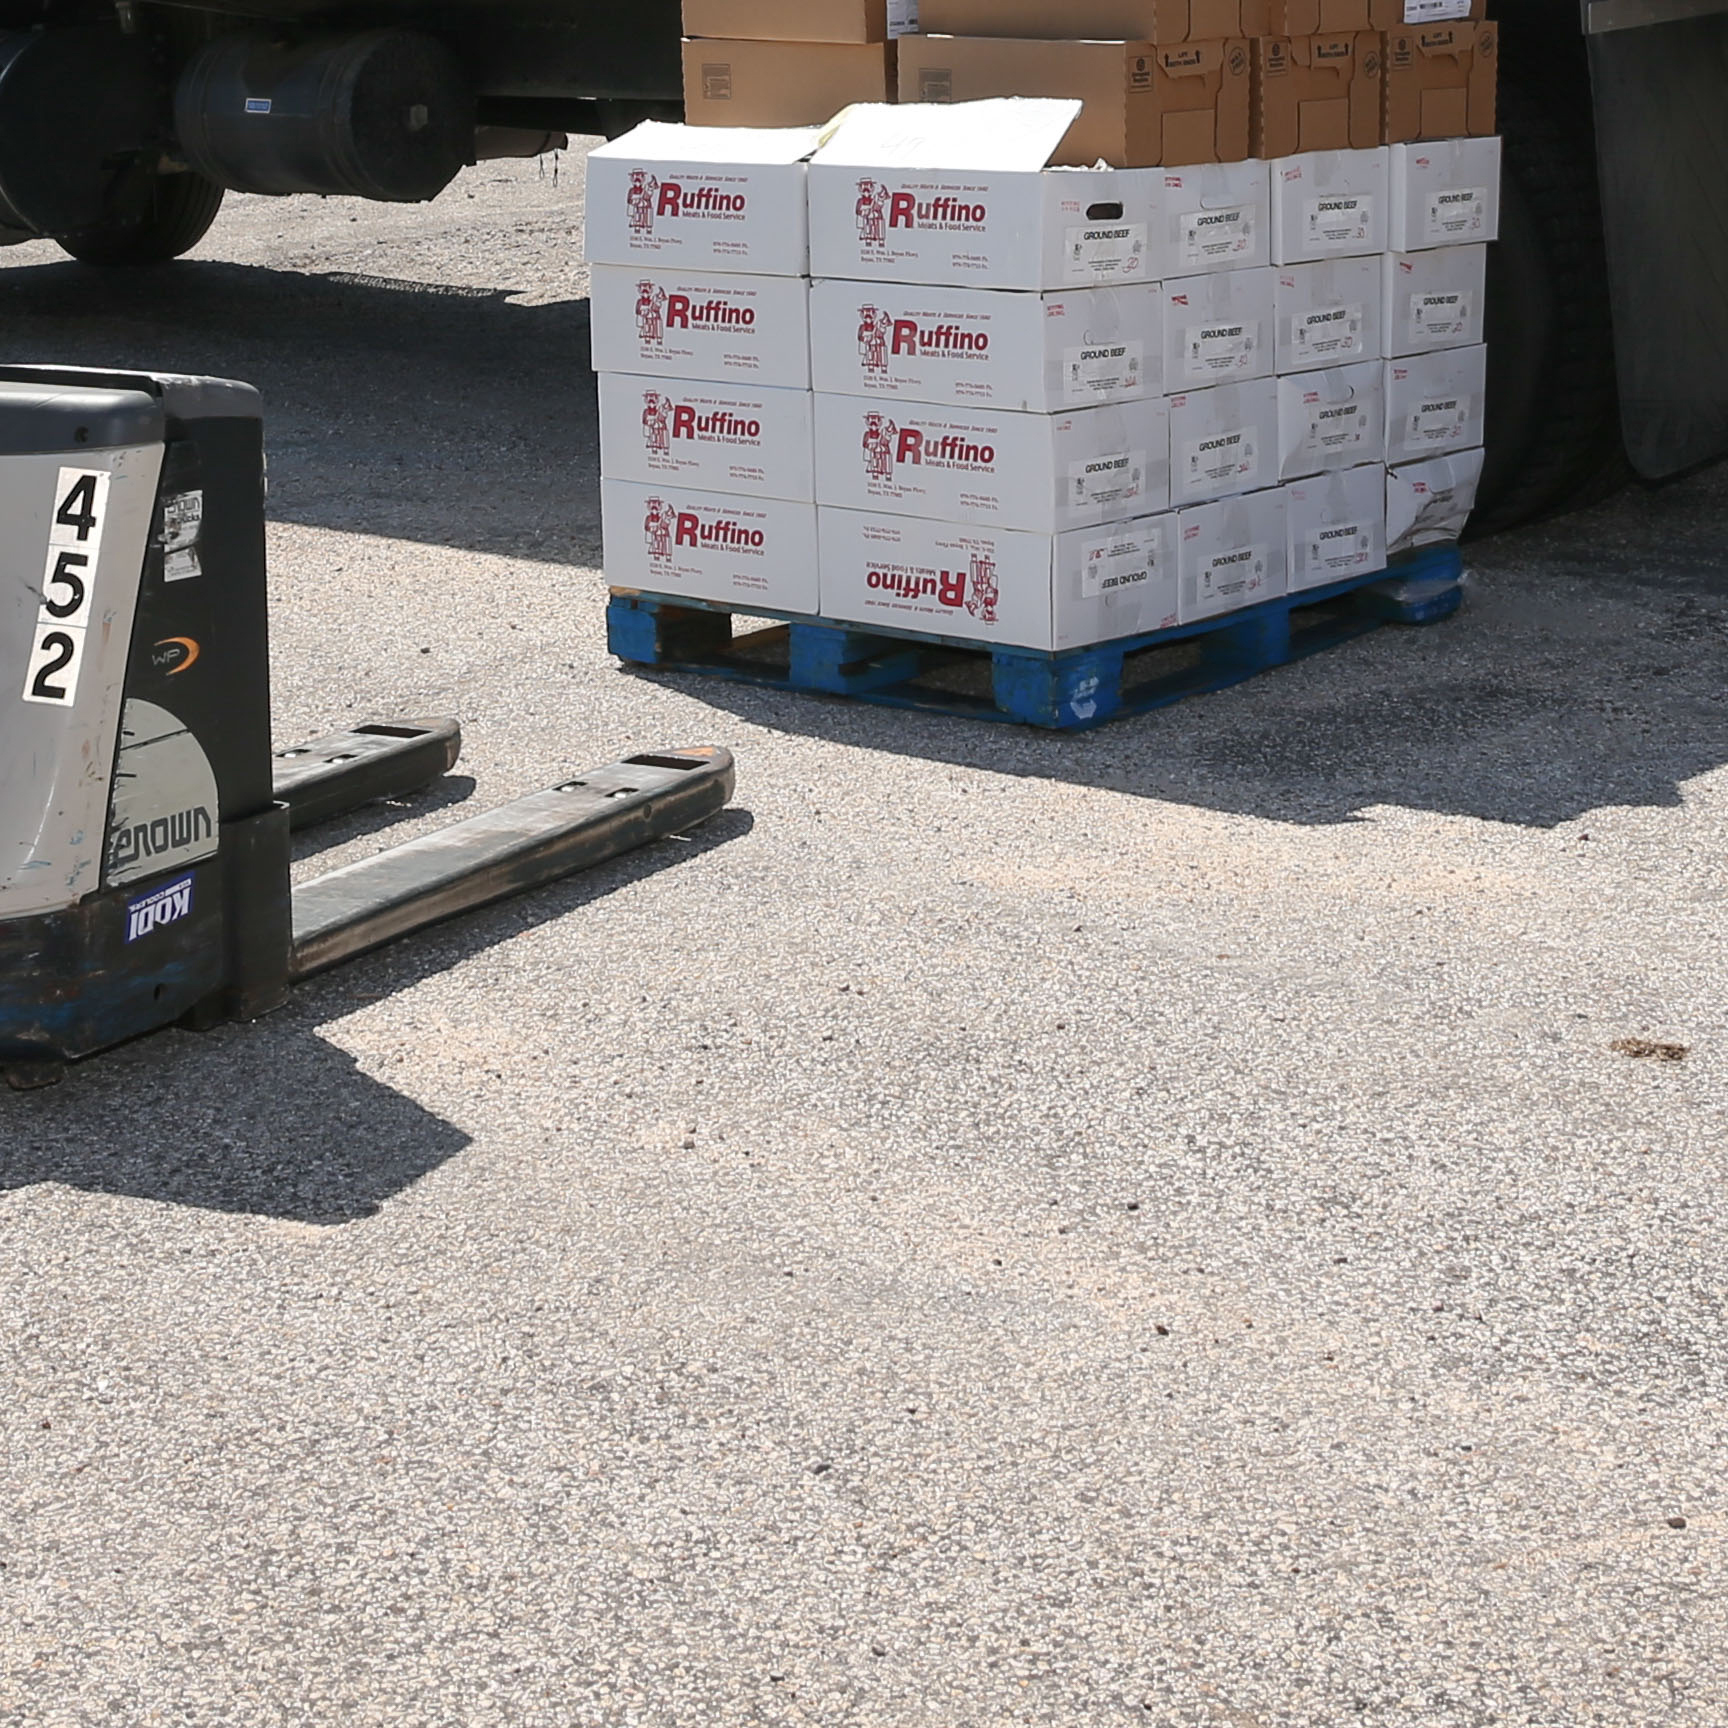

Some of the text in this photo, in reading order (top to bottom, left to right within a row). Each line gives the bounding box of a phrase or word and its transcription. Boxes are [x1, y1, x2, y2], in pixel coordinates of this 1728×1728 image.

[656, 182, 745, 217] Ruffino
[1318, 200, 1358, 212] GROUND BEEF
[889, 192, 986, 229] Ruffino
[1197, 212, 1240, 226] GROUND BEEF
[1083, 229, 1131, 241] GROUND BEEF
[1423, 295, 1459, 305] GROUND BEEF
[666, 294, 755, 329] Ruffino
[1306, 310, 1346, 325] GROUND BEEF
[891, 319, 989, 356] Ruffino
[1201, 327, 1243, 339] GROUND BEEF
[1081, 347, 1126, 360] GROUND BEEF
[672, 405, 760, 440] Ruffino
[896, 428, 995, 465] Ruffino
[1199, 434, 1241, 452] GROUND BEEF
[1085, 458, 1129, 473] GROUND BEEF
[675, 512, 764, 548] Ruffino
[1319, 526, 1358, 540] GROUND BEEF
[1212, 551, 1252, 567] GROUND BEEF
[866, 570, 967, 608] Ruffino
[152, 648, 181, 666] WP
[128, 886, 192, 942] KODI
